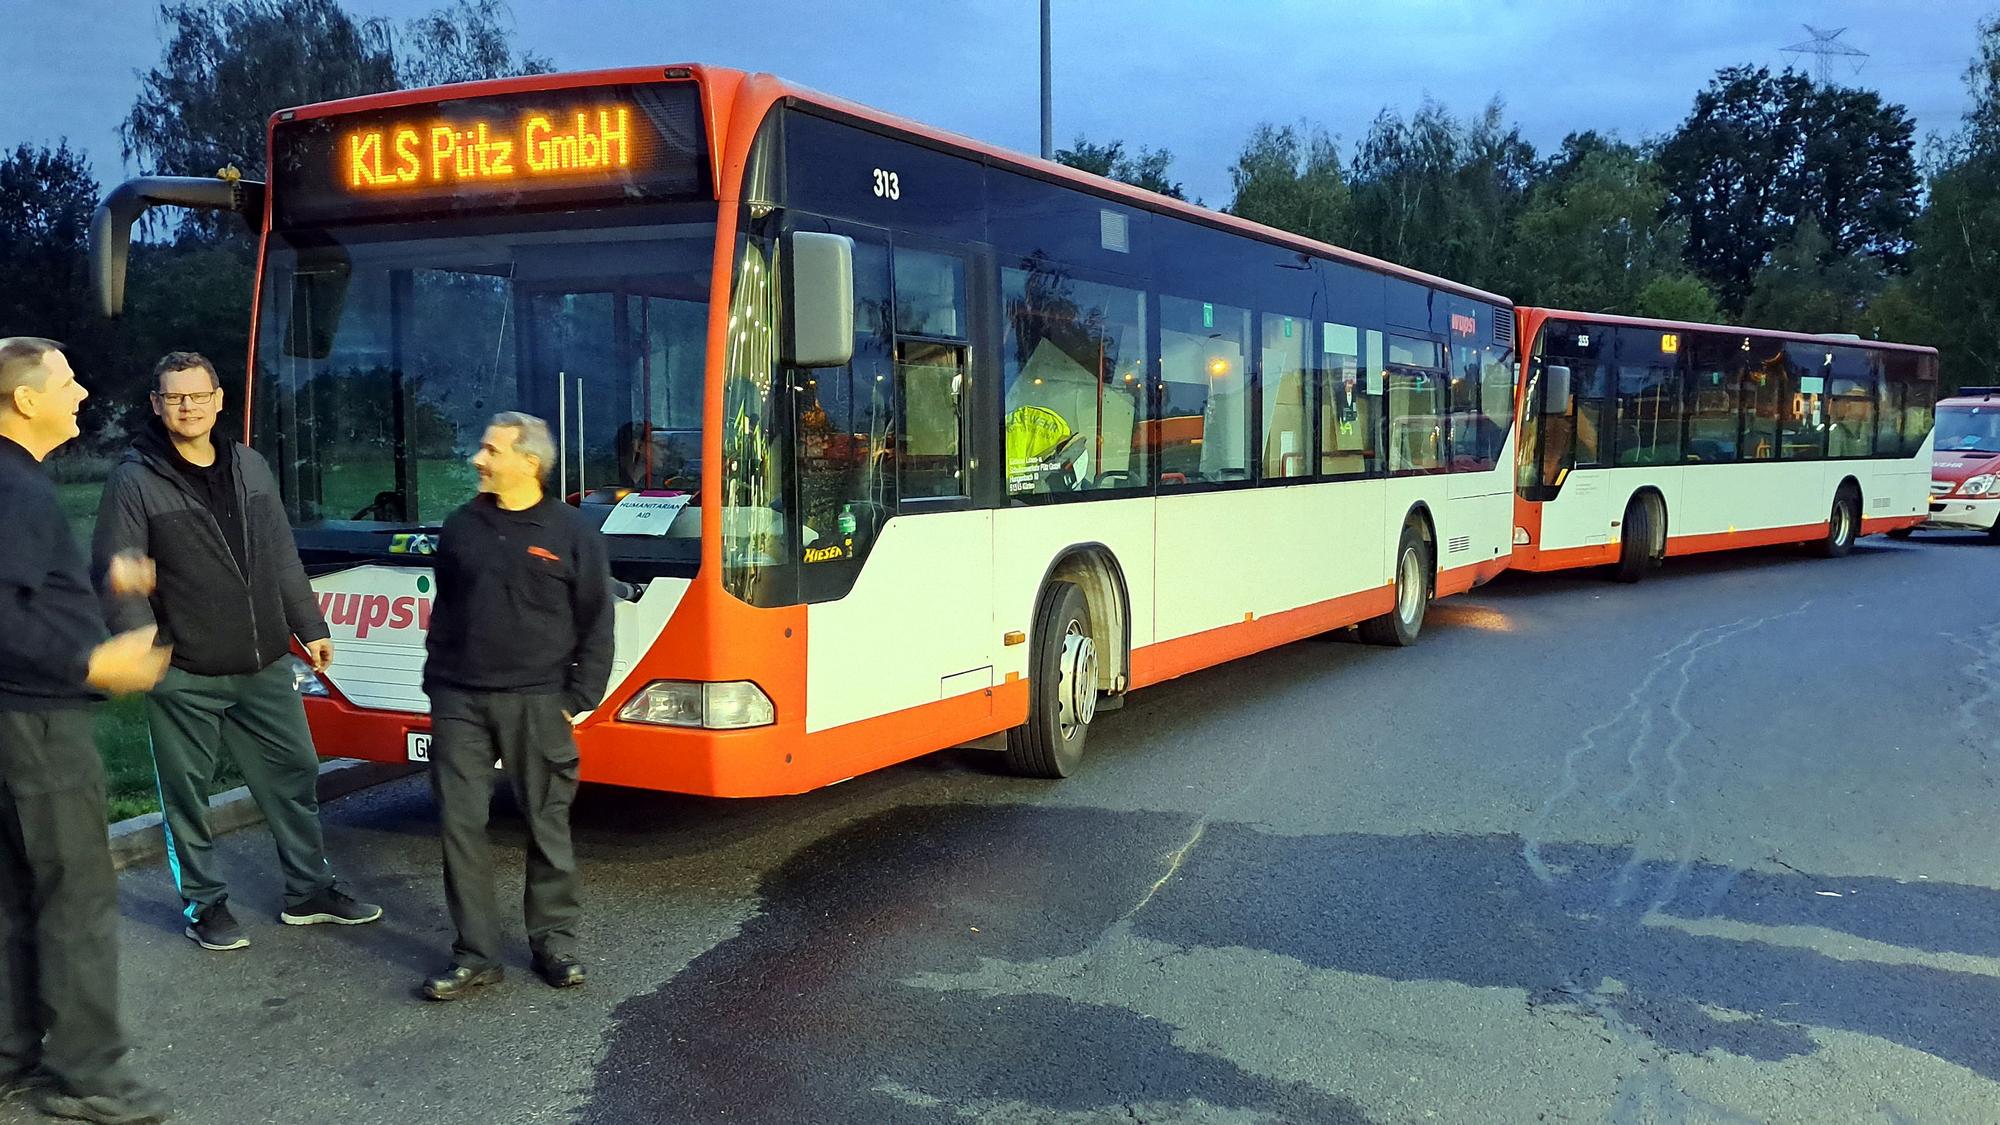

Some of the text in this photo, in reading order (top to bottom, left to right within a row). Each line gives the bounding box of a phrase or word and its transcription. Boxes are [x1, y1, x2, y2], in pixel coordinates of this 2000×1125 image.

[350, 108, 629, 187] KLS Pütz GmbH
[873, 168, 900, 200] 313
[620, 502, 682, 511] HUMANITARIAN
[636, 511, 651, 519] AID
[414, 737, 432, 759] G
